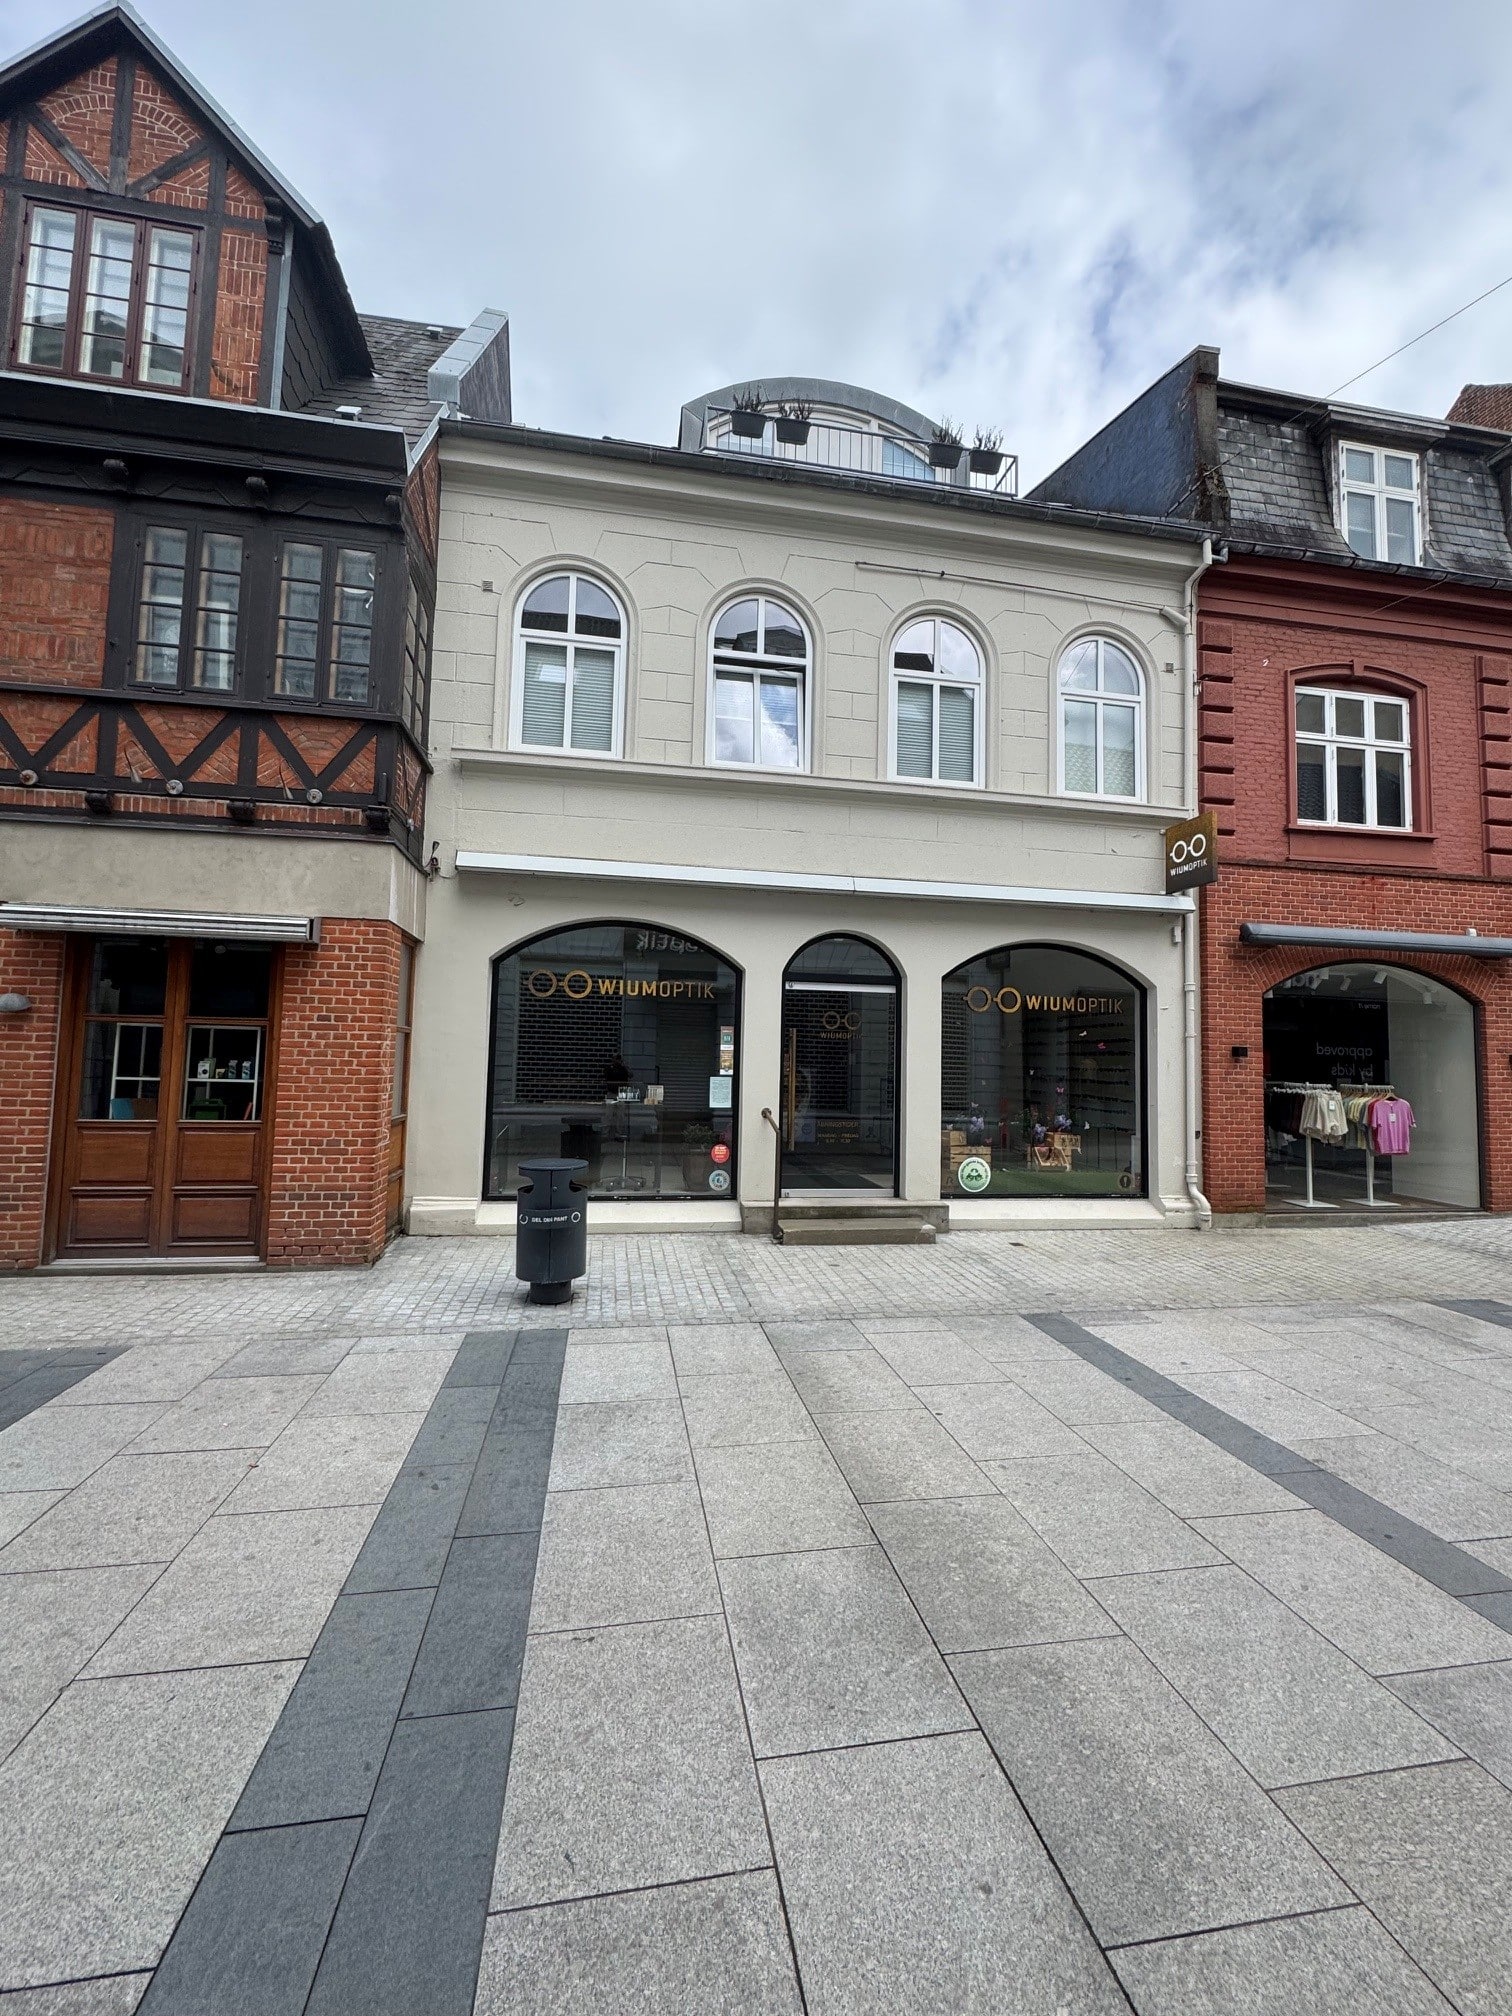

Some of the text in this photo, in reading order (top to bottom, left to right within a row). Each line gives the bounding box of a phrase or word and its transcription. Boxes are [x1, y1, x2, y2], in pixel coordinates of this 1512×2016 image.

[1170, 858, 1207, 876] WIUMOPTIK
[598, 979, 715, 998] WIUMOPTIK
[1025, 995, 1123, 1014] WIUMOPTIK
